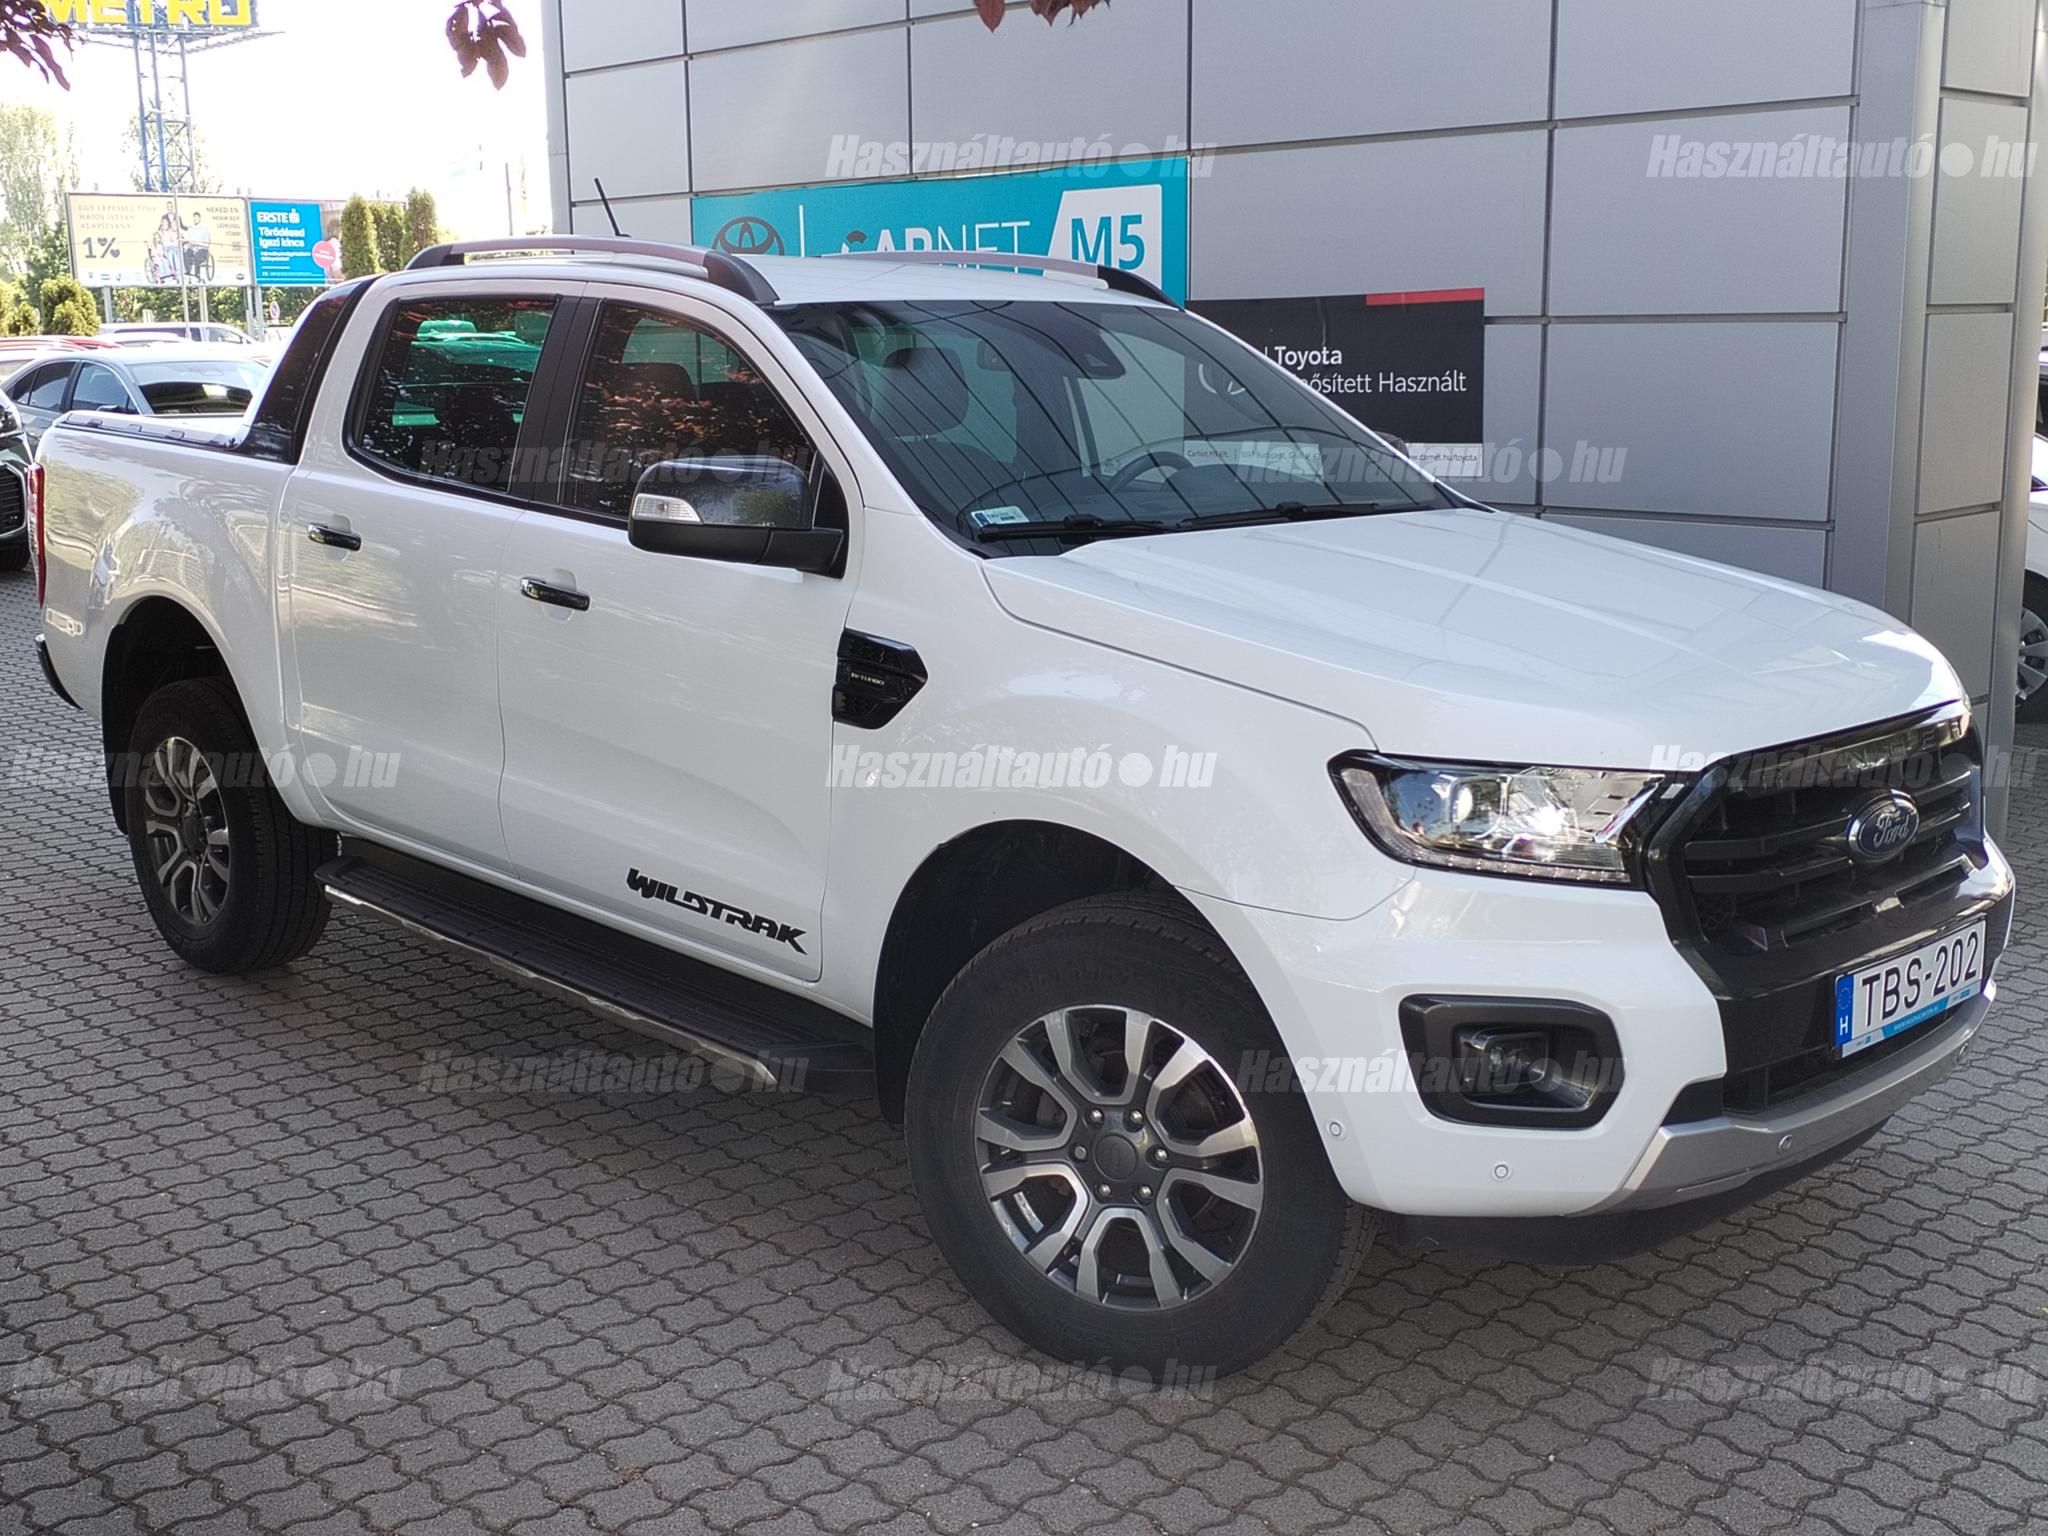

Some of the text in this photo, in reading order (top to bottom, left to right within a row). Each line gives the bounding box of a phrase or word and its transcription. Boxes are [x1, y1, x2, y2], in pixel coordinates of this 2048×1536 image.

[256, 211, 289, 223] ERSTE
[82, 236, 121, 259] 1%
[1070, 214, 1145, 270] M5
[1274, 346, 1342, 370] Toyota
[1378, 370, 1467, 392] Használt
[1872, 812, 1911, 848] Ford
[1862, 931, 1978, 1027] TBS-202
[1839, 1015, 1849, 1036] H
